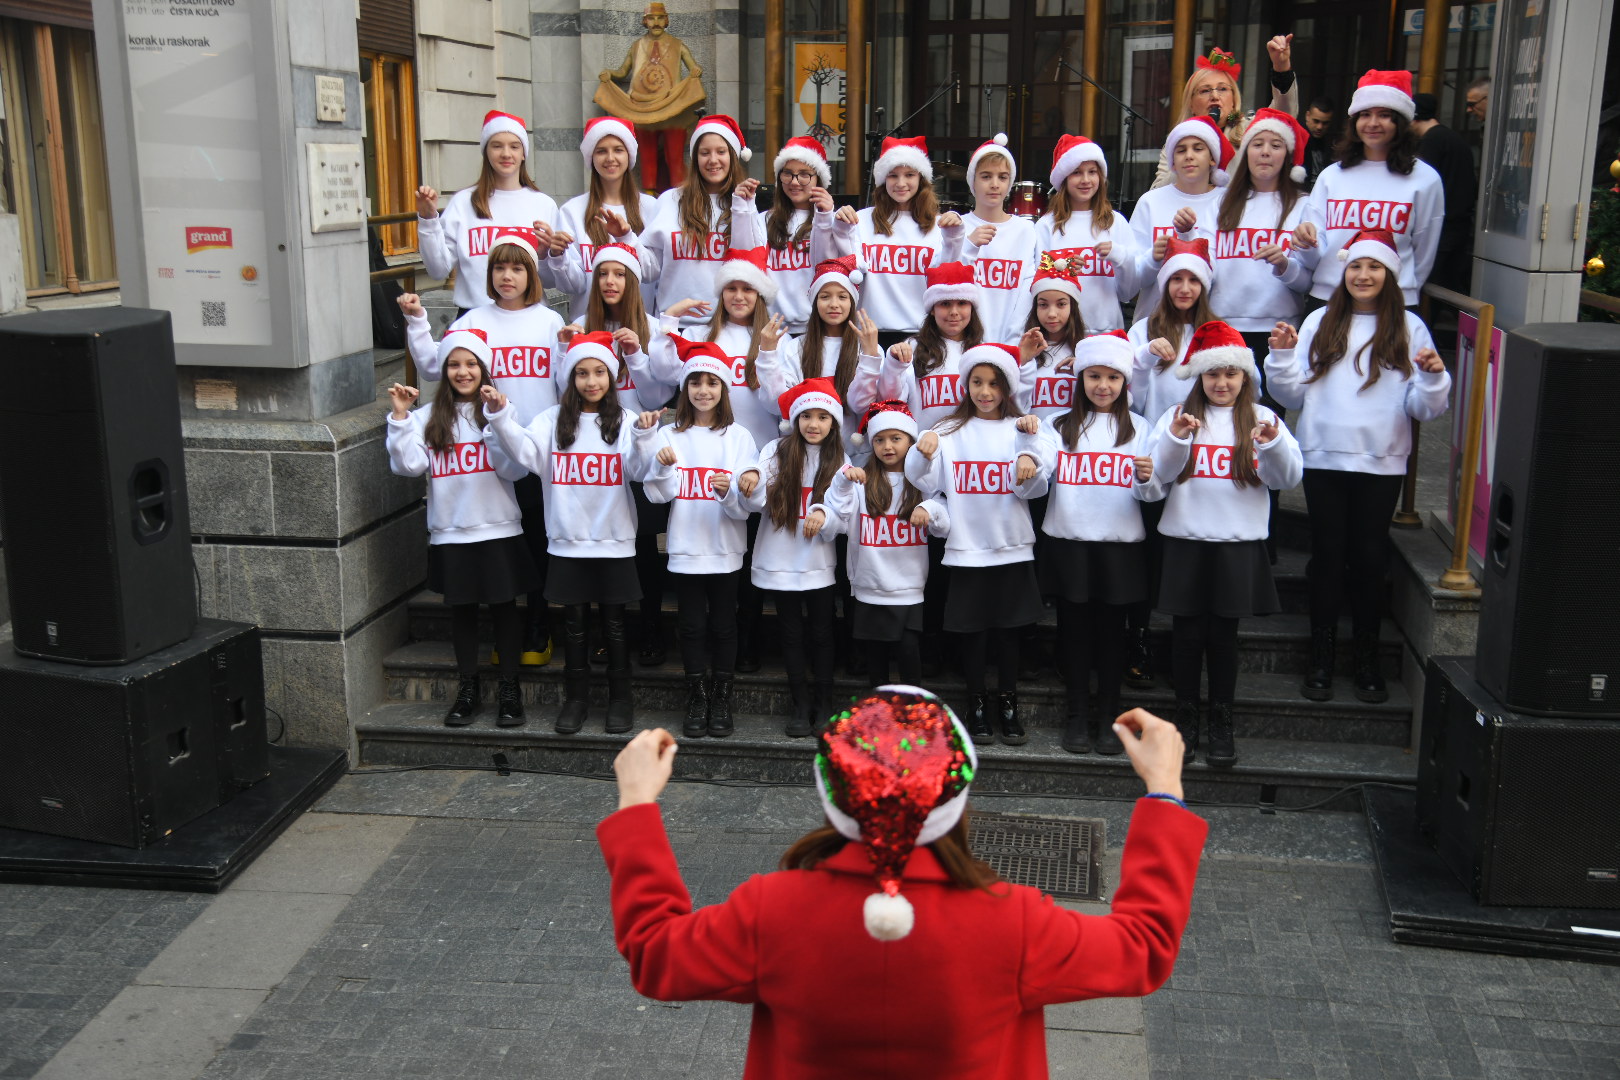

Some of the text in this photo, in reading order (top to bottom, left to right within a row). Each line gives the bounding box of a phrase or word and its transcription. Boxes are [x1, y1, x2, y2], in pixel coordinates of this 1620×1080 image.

[128, 34, 210, 47] korak u raskorak
[1328, 201, 1408, 232] MAGIC
[191, 231, 228, 244] grand
[676, 233, 727, 259] MAG
[975, 260, 1018, 288] AGIC
[493, 348, 547, 376] AGIC
[552, 455, 619, 483] MAGIC
[1059, 453, 1134, 485] MAGIC
[677, 469, 716, 498] MAG
